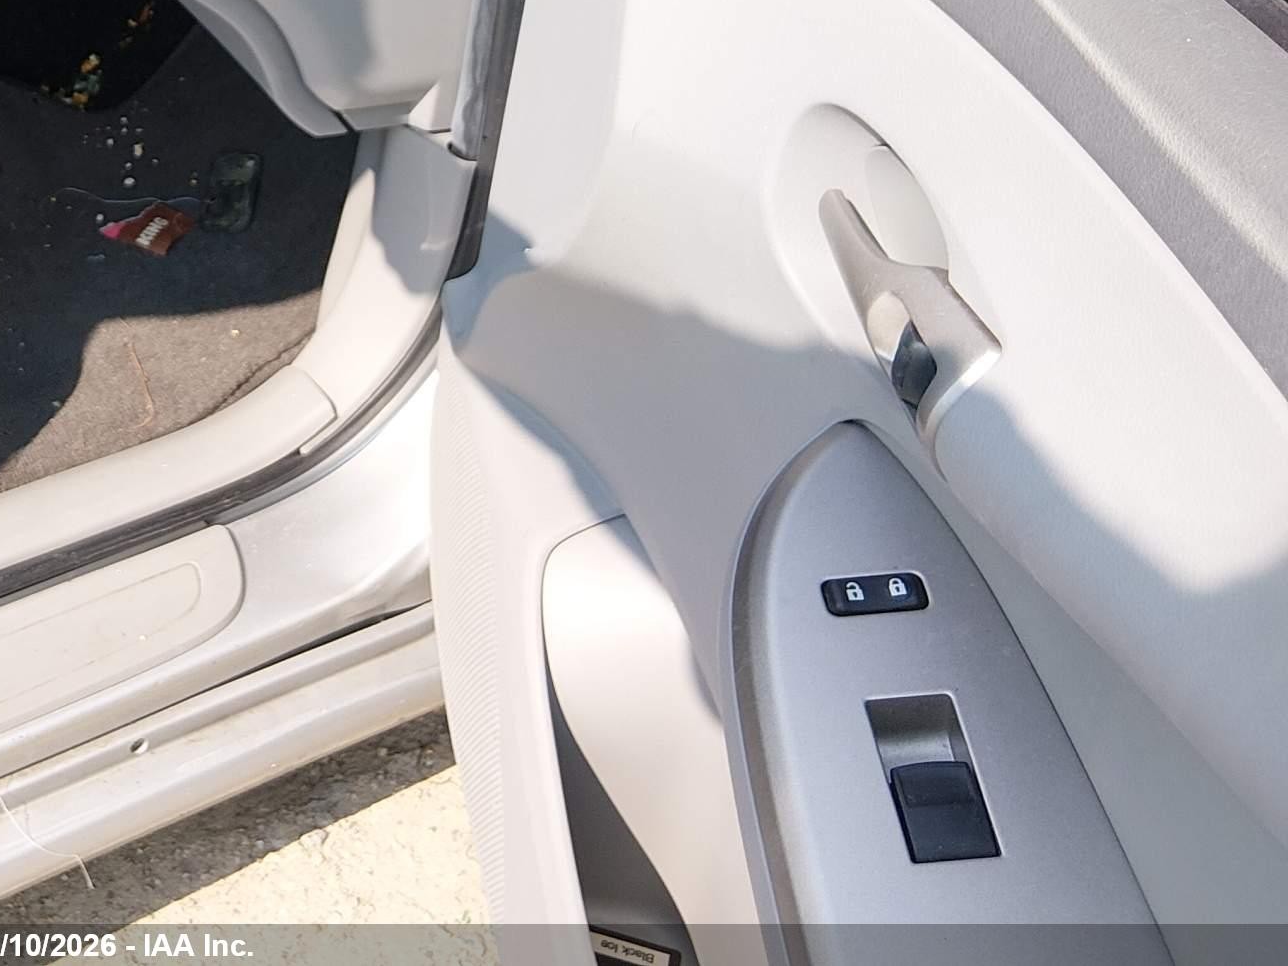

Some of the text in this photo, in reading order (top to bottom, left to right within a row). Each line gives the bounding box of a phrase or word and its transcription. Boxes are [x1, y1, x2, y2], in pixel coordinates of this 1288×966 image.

[135, 217, 169, 246] KING
[600, 939, 655, 964] Black Ice
